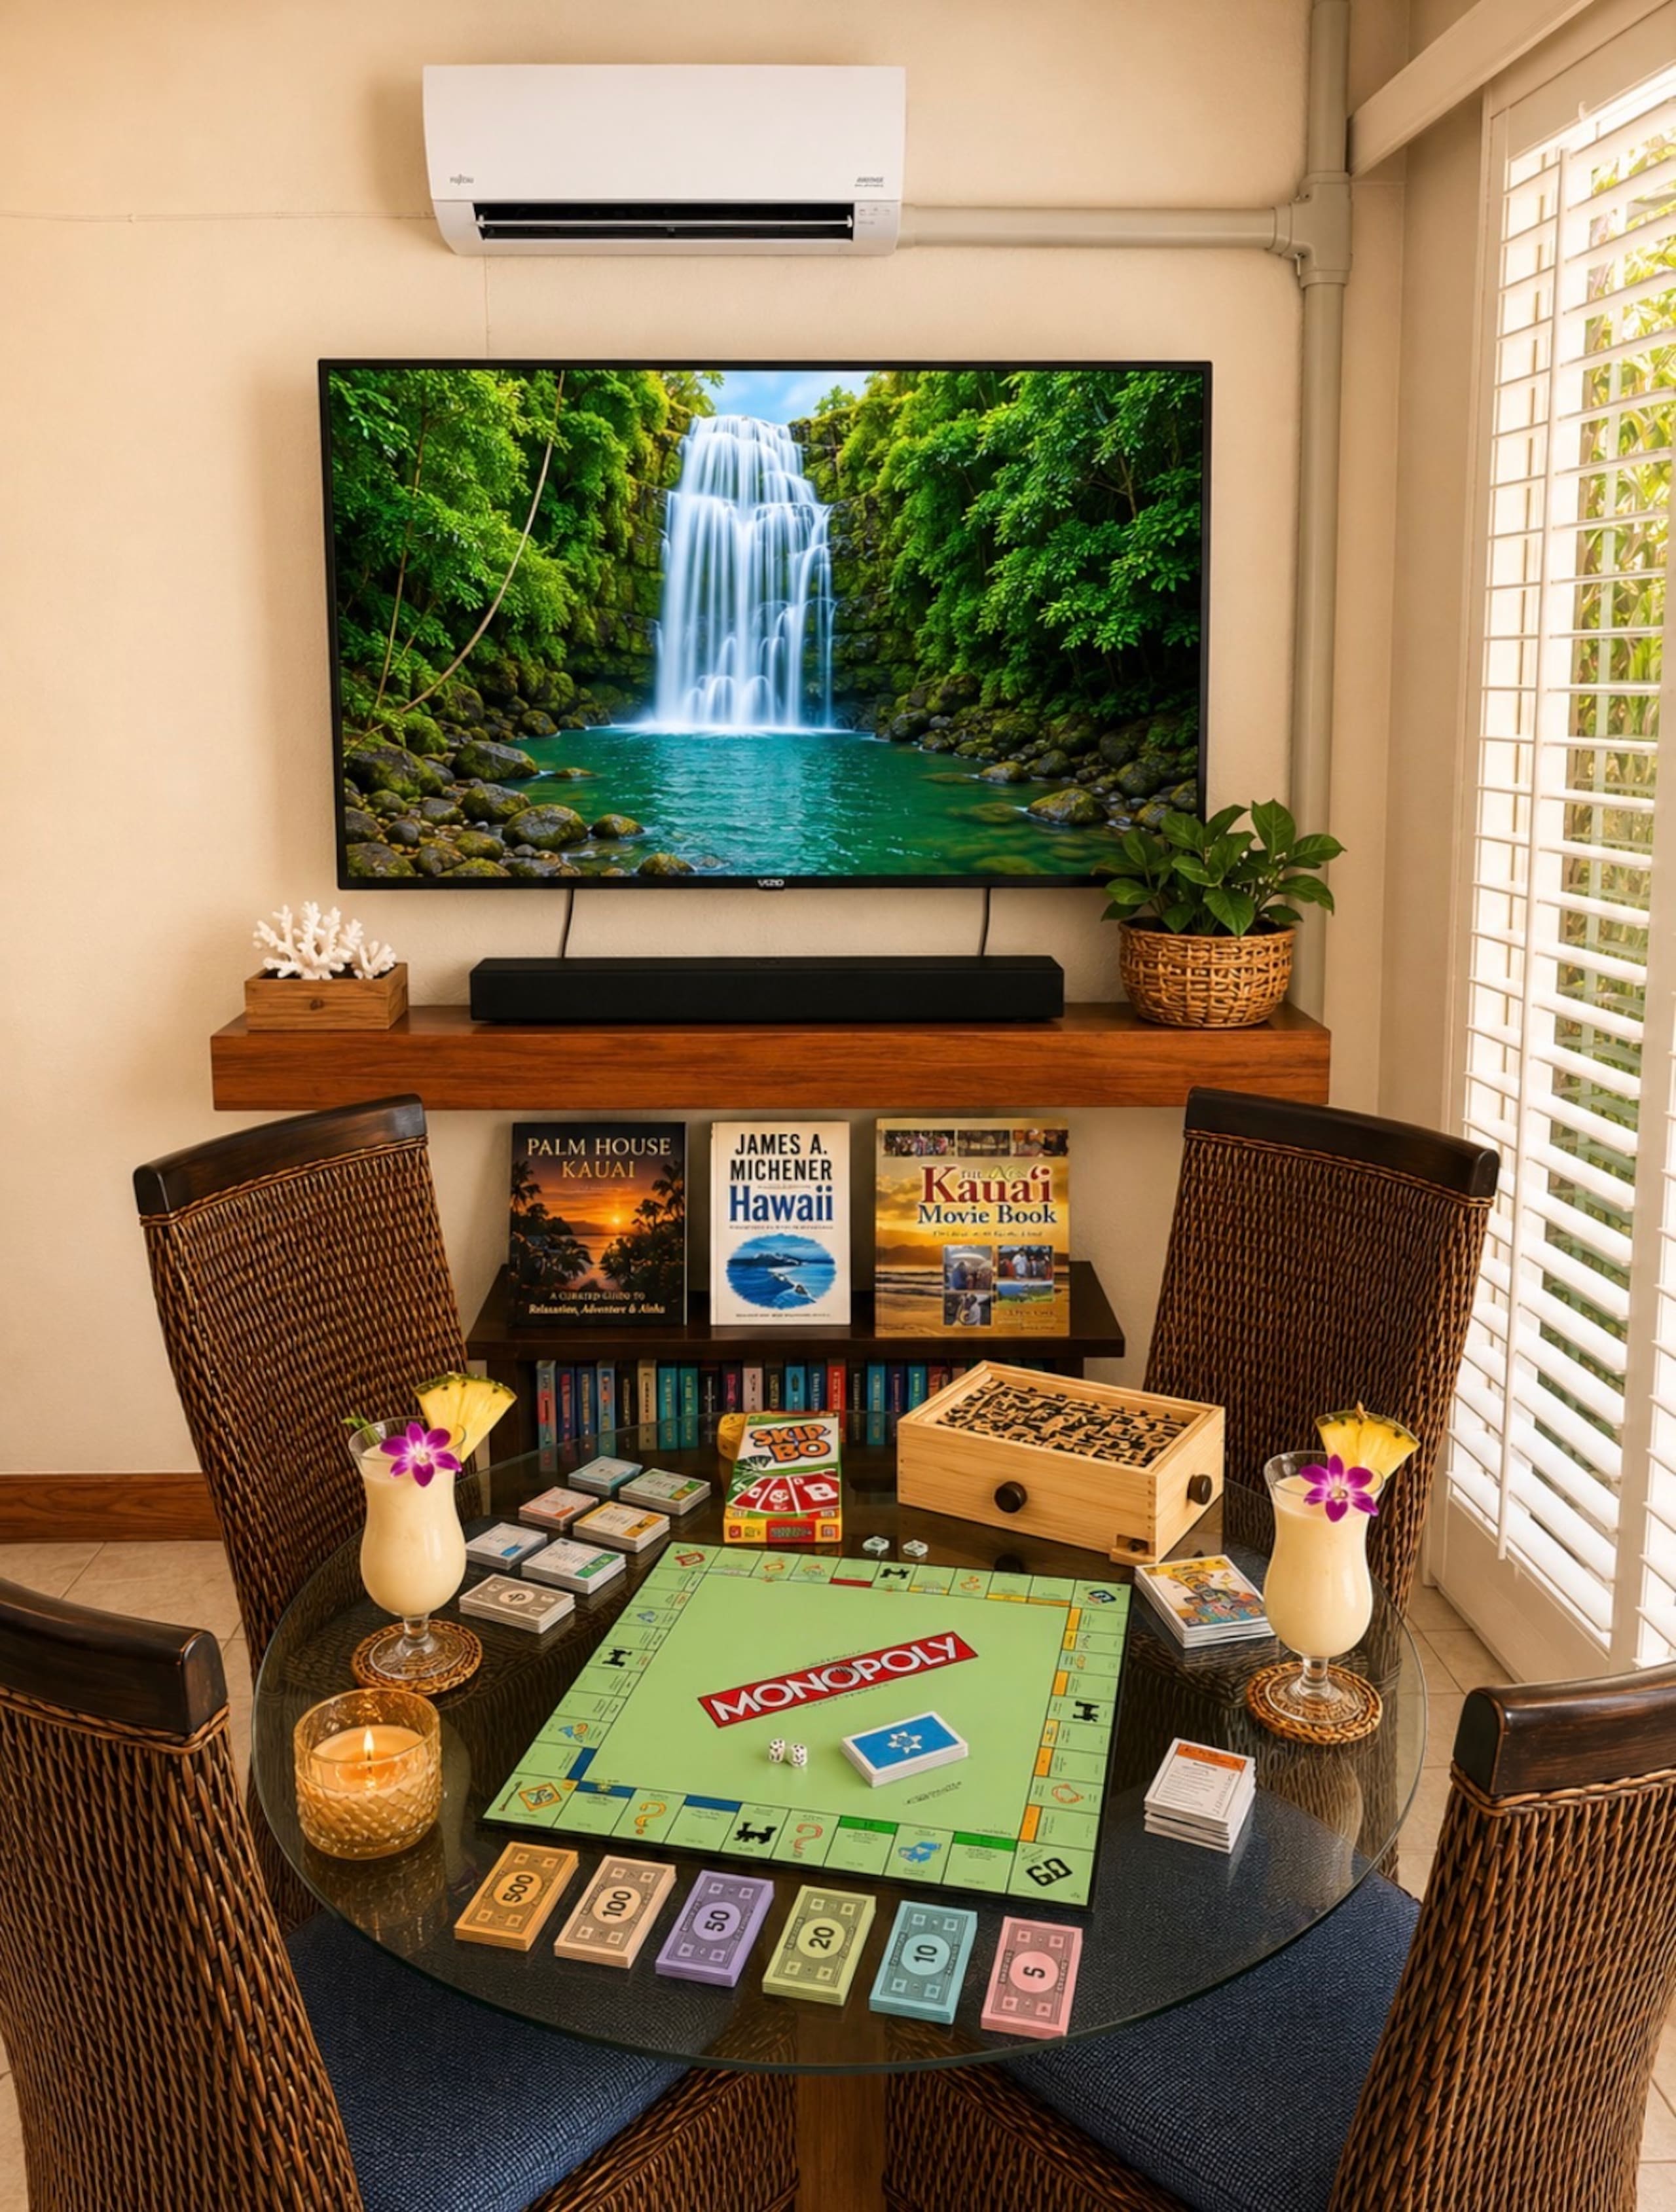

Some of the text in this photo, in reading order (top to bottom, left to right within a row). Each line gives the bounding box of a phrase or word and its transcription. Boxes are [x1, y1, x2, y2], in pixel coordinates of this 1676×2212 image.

[527, 1138, 671, 1156] PALM HOUSE
[735, 1134, 828, 1155] JAMES A.
[562, 1161, 634, 1178] KAUAI
[731, 1159, 832, 1181] MICHENER
[729, 1185, 833, 1222] Hawaii
[918, 1204, 1057, 1224] Movie Book
[770, 1440, 830, 1463] BO
[710, 1637, 955, 1721] MONOPOLY
[502, 1875, 534, 1902] 500
[602, 1891, 631, 1917] 100
[704, 1910, 730, 1932] 50
[809, 1927, 835, 1949] 20
[914, 1945, 937, 1963] 10
[1023, 1966, 1046, 1978] 5
